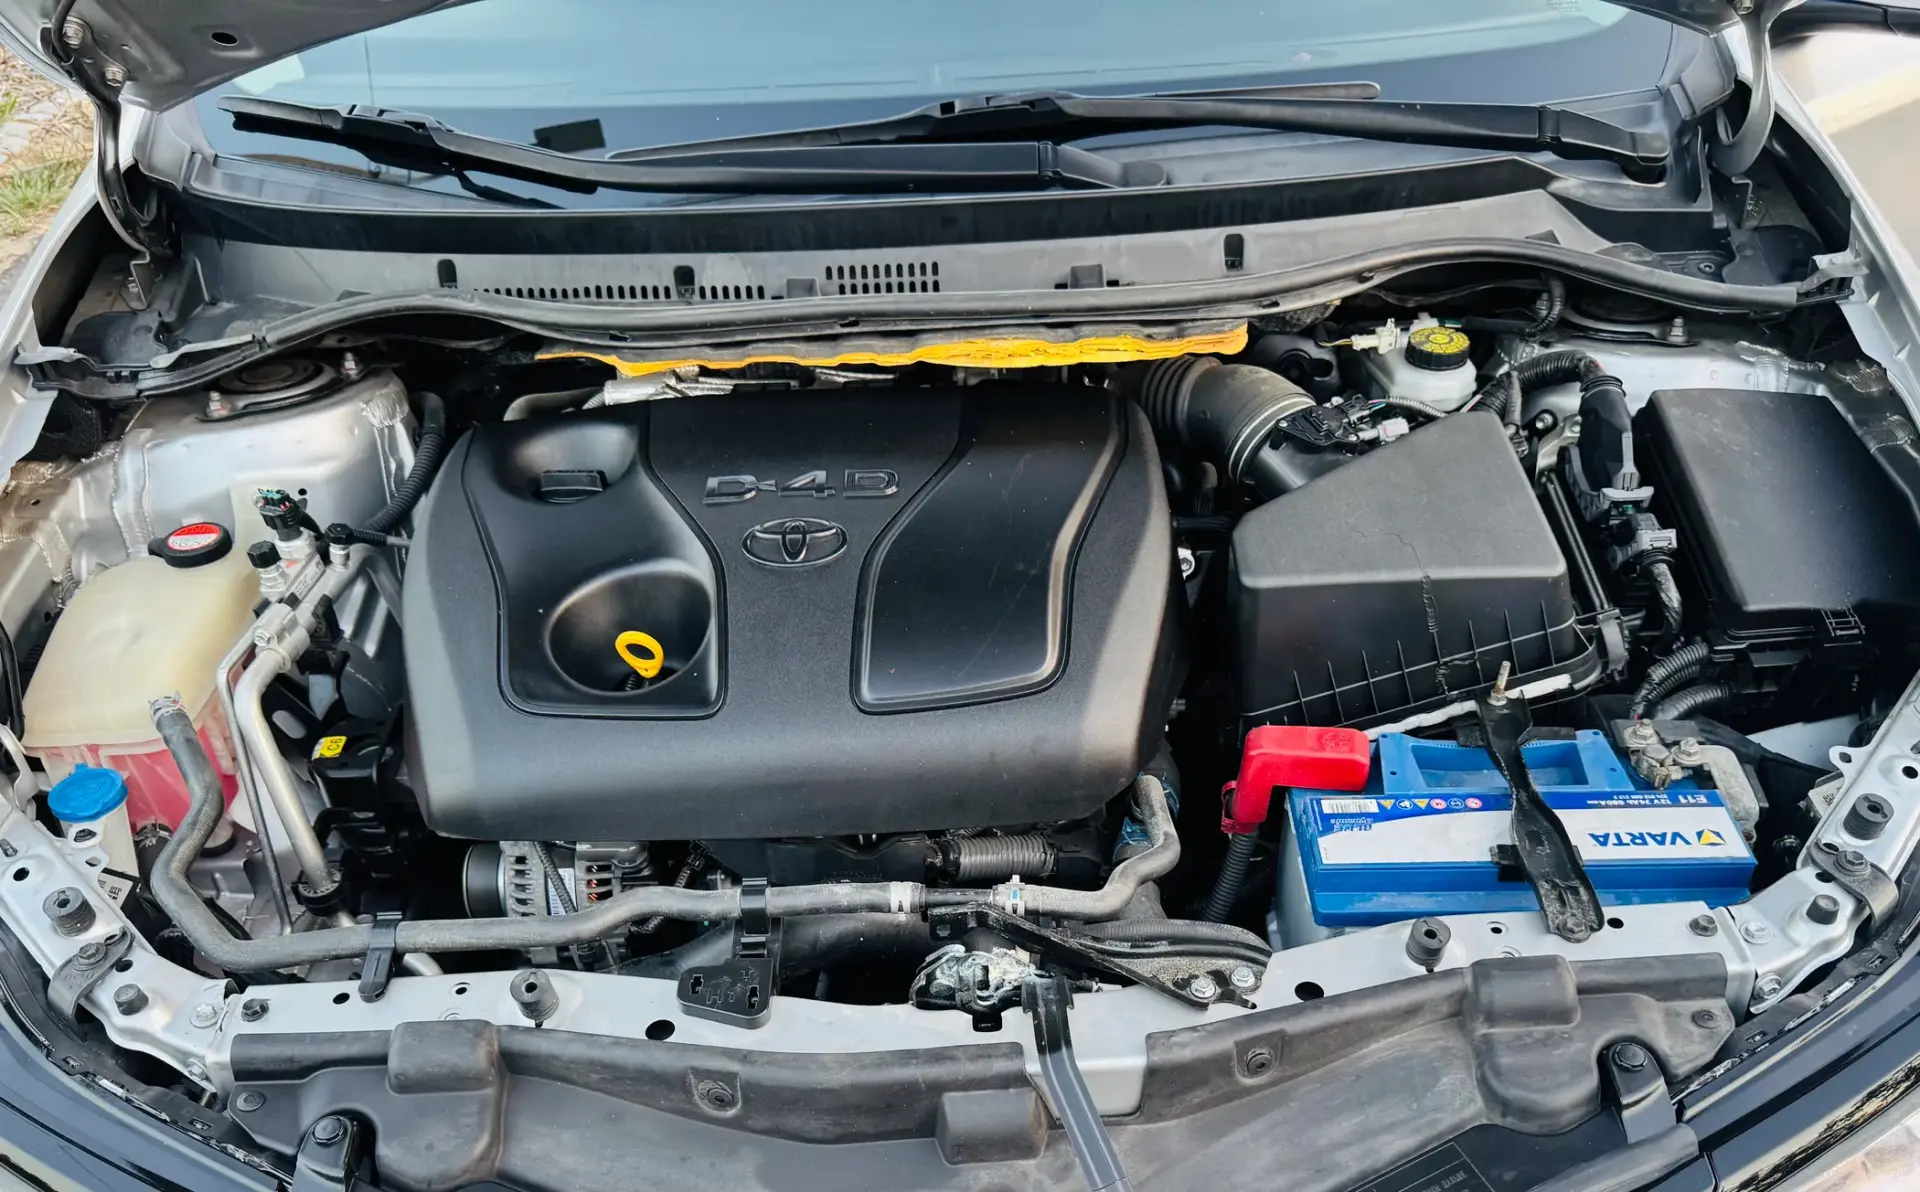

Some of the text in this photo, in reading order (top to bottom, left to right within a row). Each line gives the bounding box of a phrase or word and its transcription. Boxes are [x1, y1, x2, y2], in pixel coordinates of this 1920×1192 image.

[703, 469, 899, 504] D-4D
[1678, 794, 1708, 804] E11
[1588, 831, 1692, 847] VARTA
